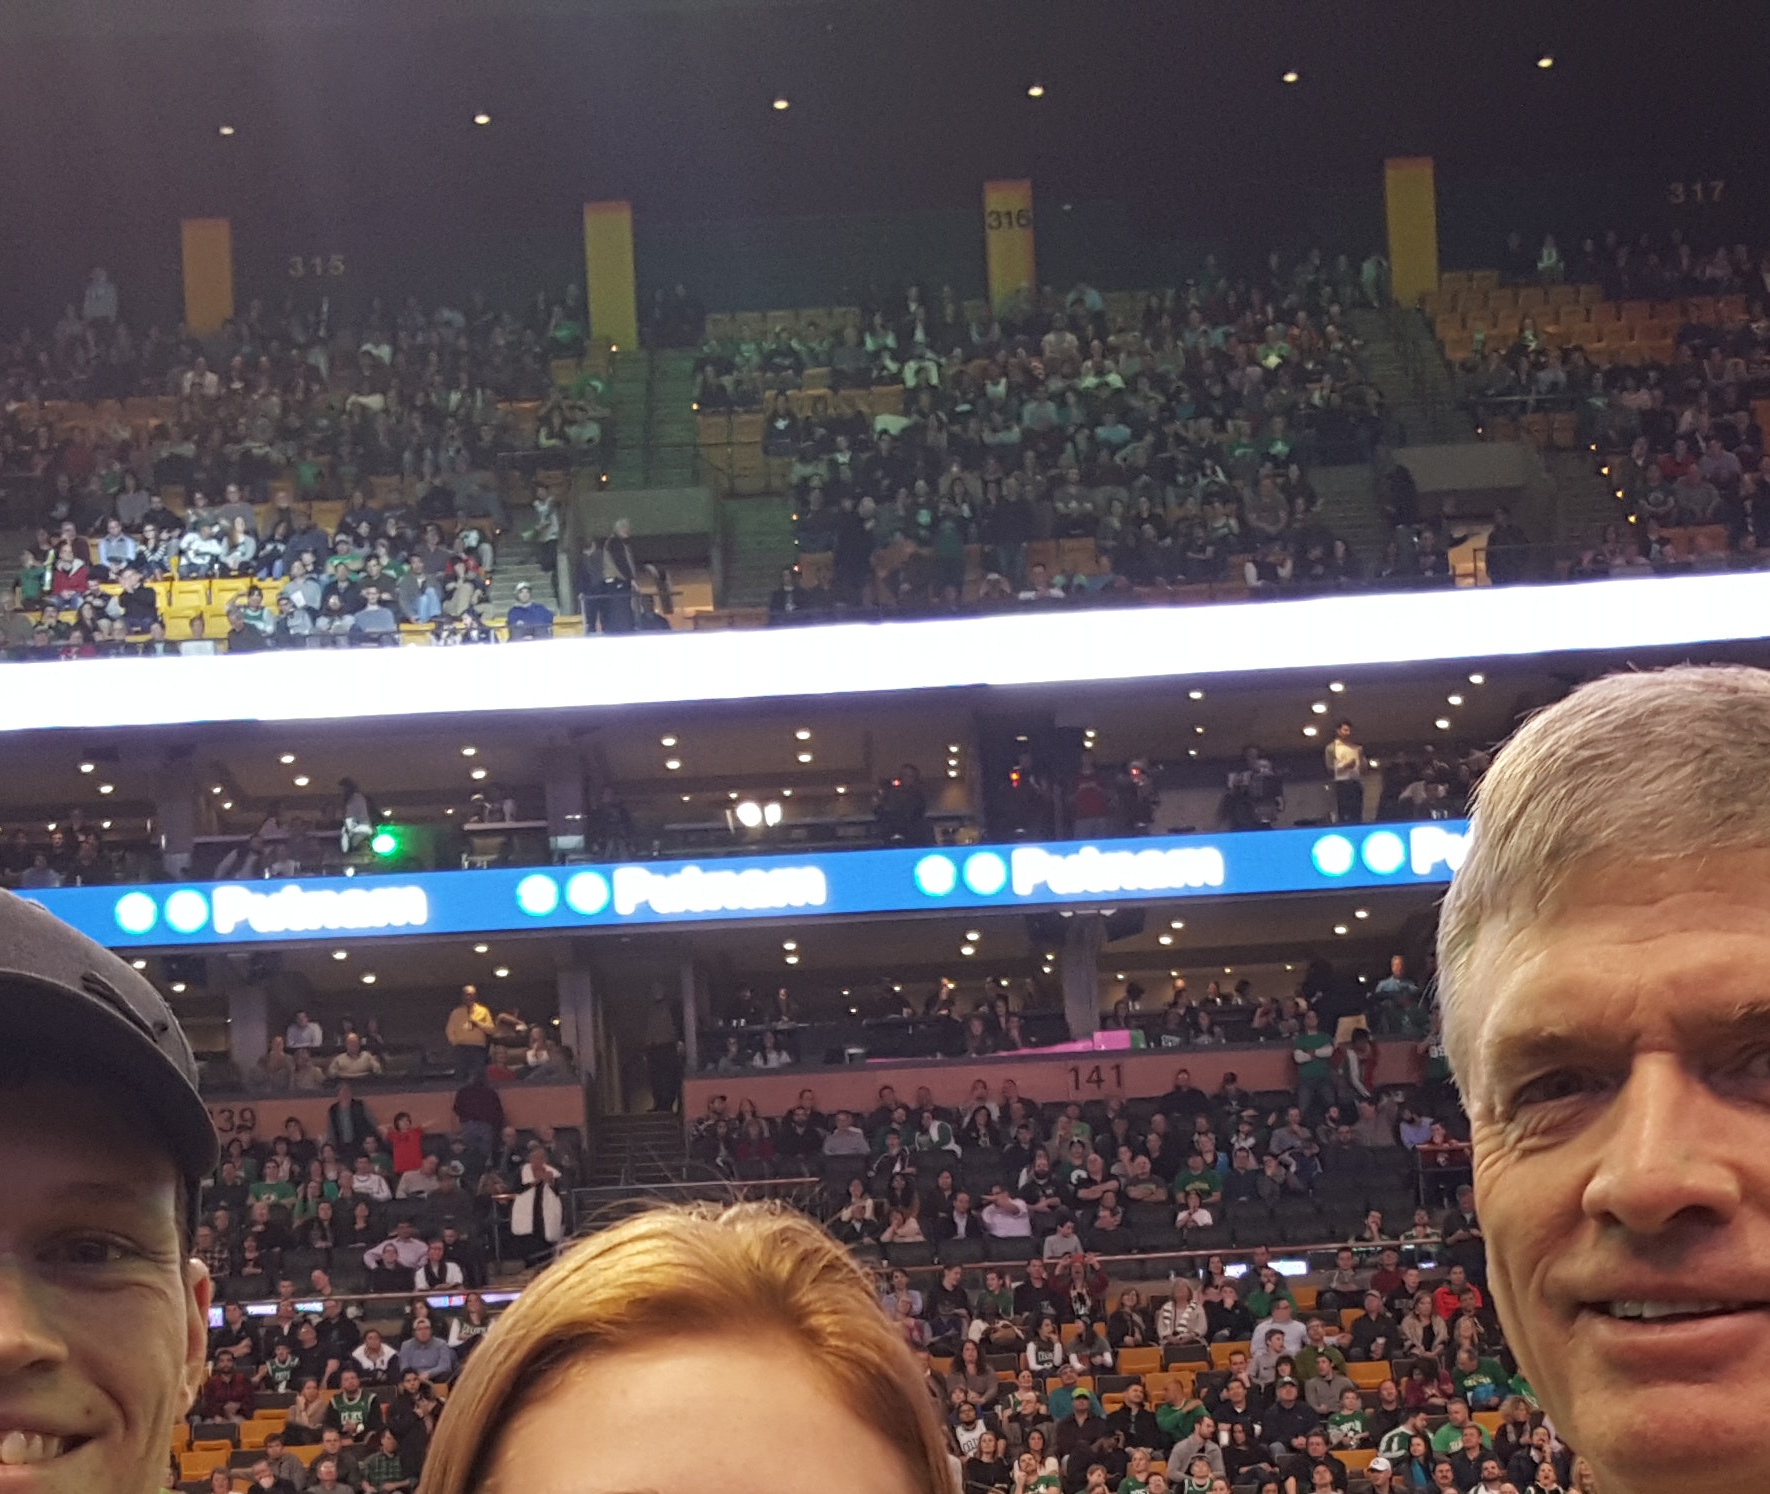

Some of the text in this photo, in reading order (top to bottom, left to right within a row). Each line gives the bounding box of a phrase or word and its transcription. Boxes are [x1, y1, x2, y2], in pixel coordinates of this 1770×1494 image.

[1669, 179, 1726, 205] 317
[987, 208, 1033, 231] 316
[288, 254, 346, 279] 315
[1069, 1063, 1124, 1091] 141
[208, 1107, 256, 1132] 39
